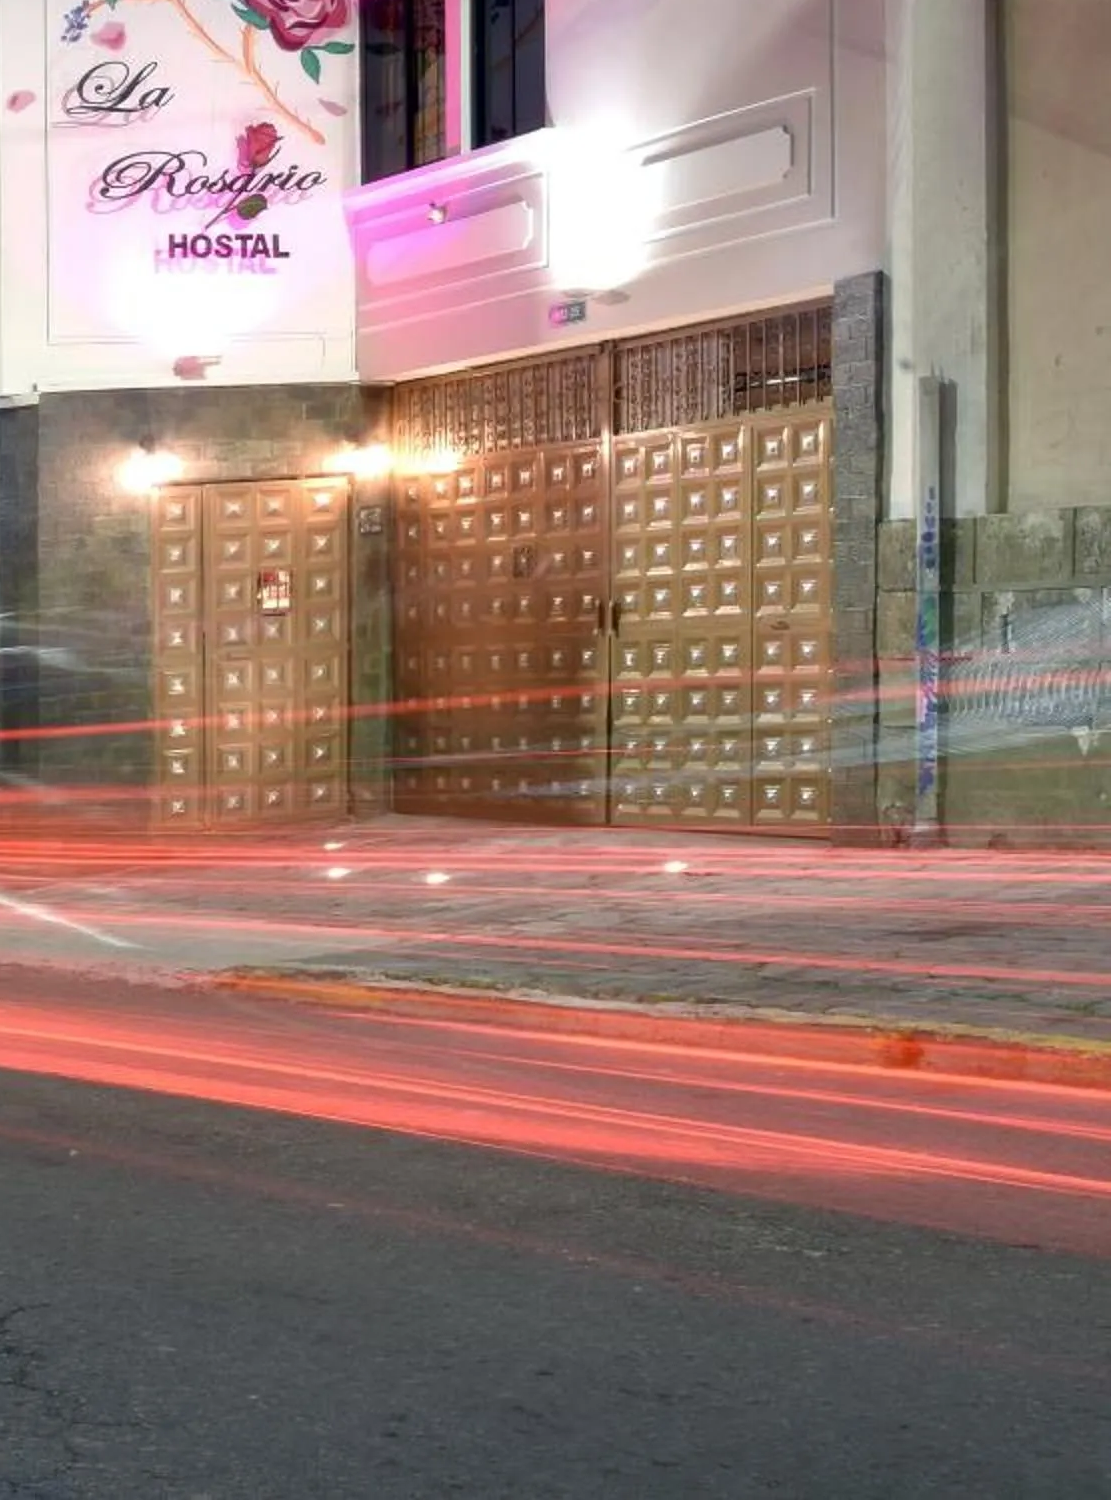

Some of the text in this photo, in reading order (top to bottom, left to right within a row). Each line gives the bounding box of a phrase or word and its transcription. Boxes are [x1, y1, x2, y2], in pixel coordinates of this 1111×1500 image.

[66, 61, 175, 114] La
[100, 150, 327, 200] Rosario
[169, 234, 290, 259] HOSTAL
